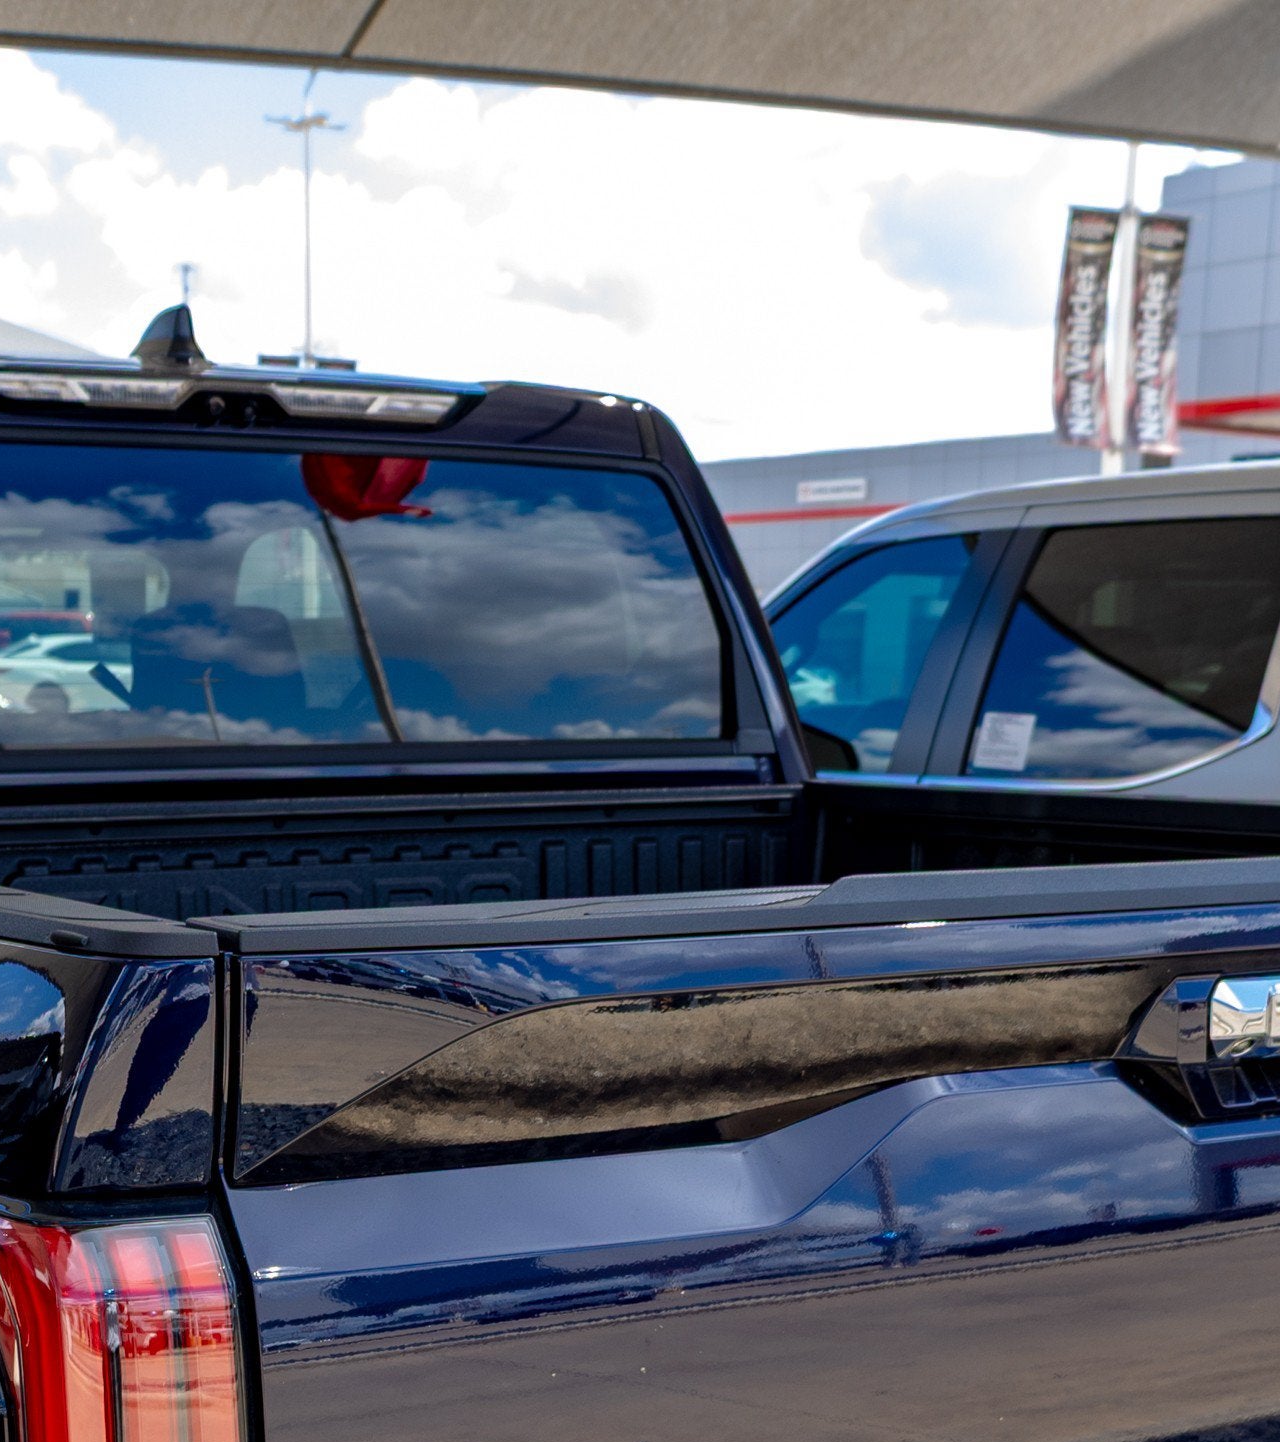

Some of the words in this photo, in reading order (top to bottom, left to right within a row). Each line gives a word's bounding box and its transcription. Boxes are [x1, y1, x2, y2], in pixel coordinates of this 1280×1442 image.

[1065, 264, 1098, 376] Vehicles
[1135, 272, 1168, 381] Vehicles
[1066, 381, 1095, 436] New
[1136, 385, 1164, 440] New
